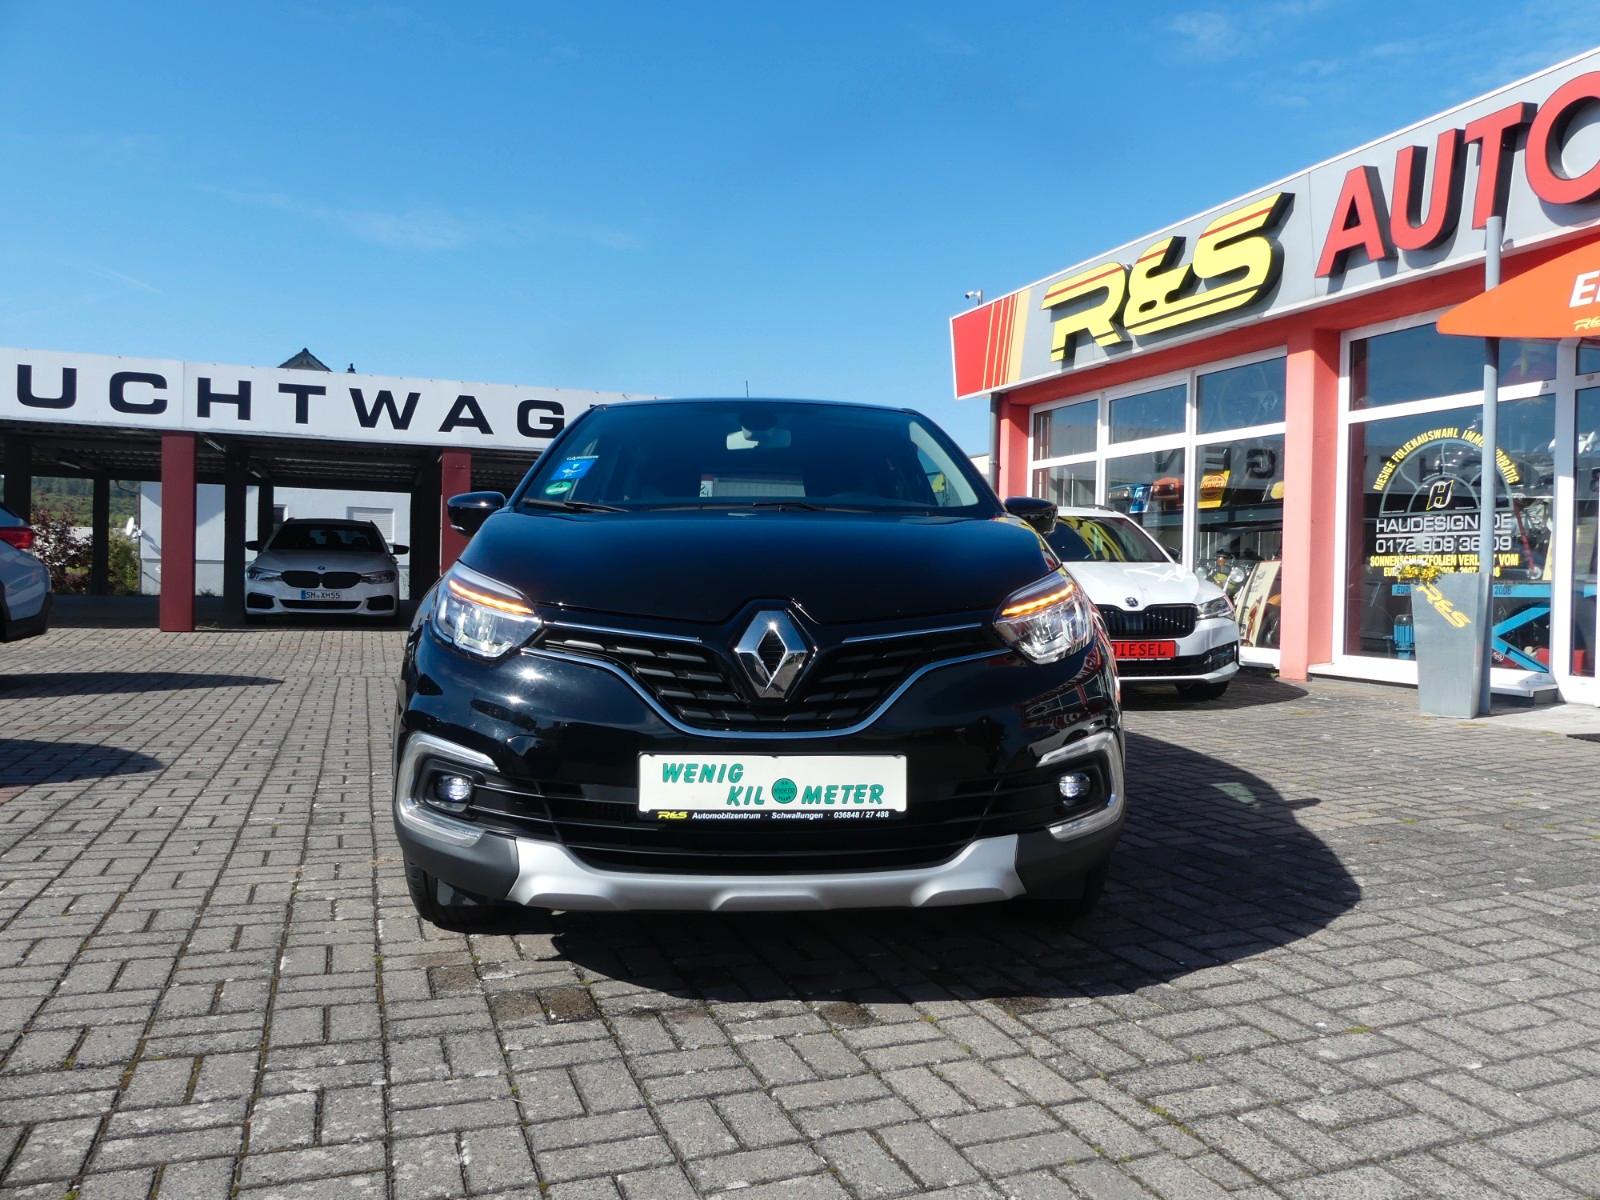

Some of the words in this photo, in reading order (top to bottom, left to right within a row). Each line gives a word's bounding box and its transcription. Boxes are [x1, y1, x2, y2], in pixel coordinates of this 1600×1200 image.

[1042, 192, 1295, 362] R&S
[1315, 70, 1600, 278] AUTO
[1568, 270, 1600, 308] E
[17, 364, 566, 439] UCHTWAG
[1373, 461, 1396, 491] RIESIGE
[1391, 427, 1459, 463] FOLIENAUSWAHL
[1461, 429, 1485, 448] IMME
[1495, 447, 1520, 485] ORRÄTIG
[1376, 514, 1512, 533] HAUDESIGNE
[1499, 553, 1519, 566] VOM
[661, 762, 744, 783] WENIG
[692, 812, 761, 820] Automobilzentrum
[771, 811, 823, 821] Schwallungen
